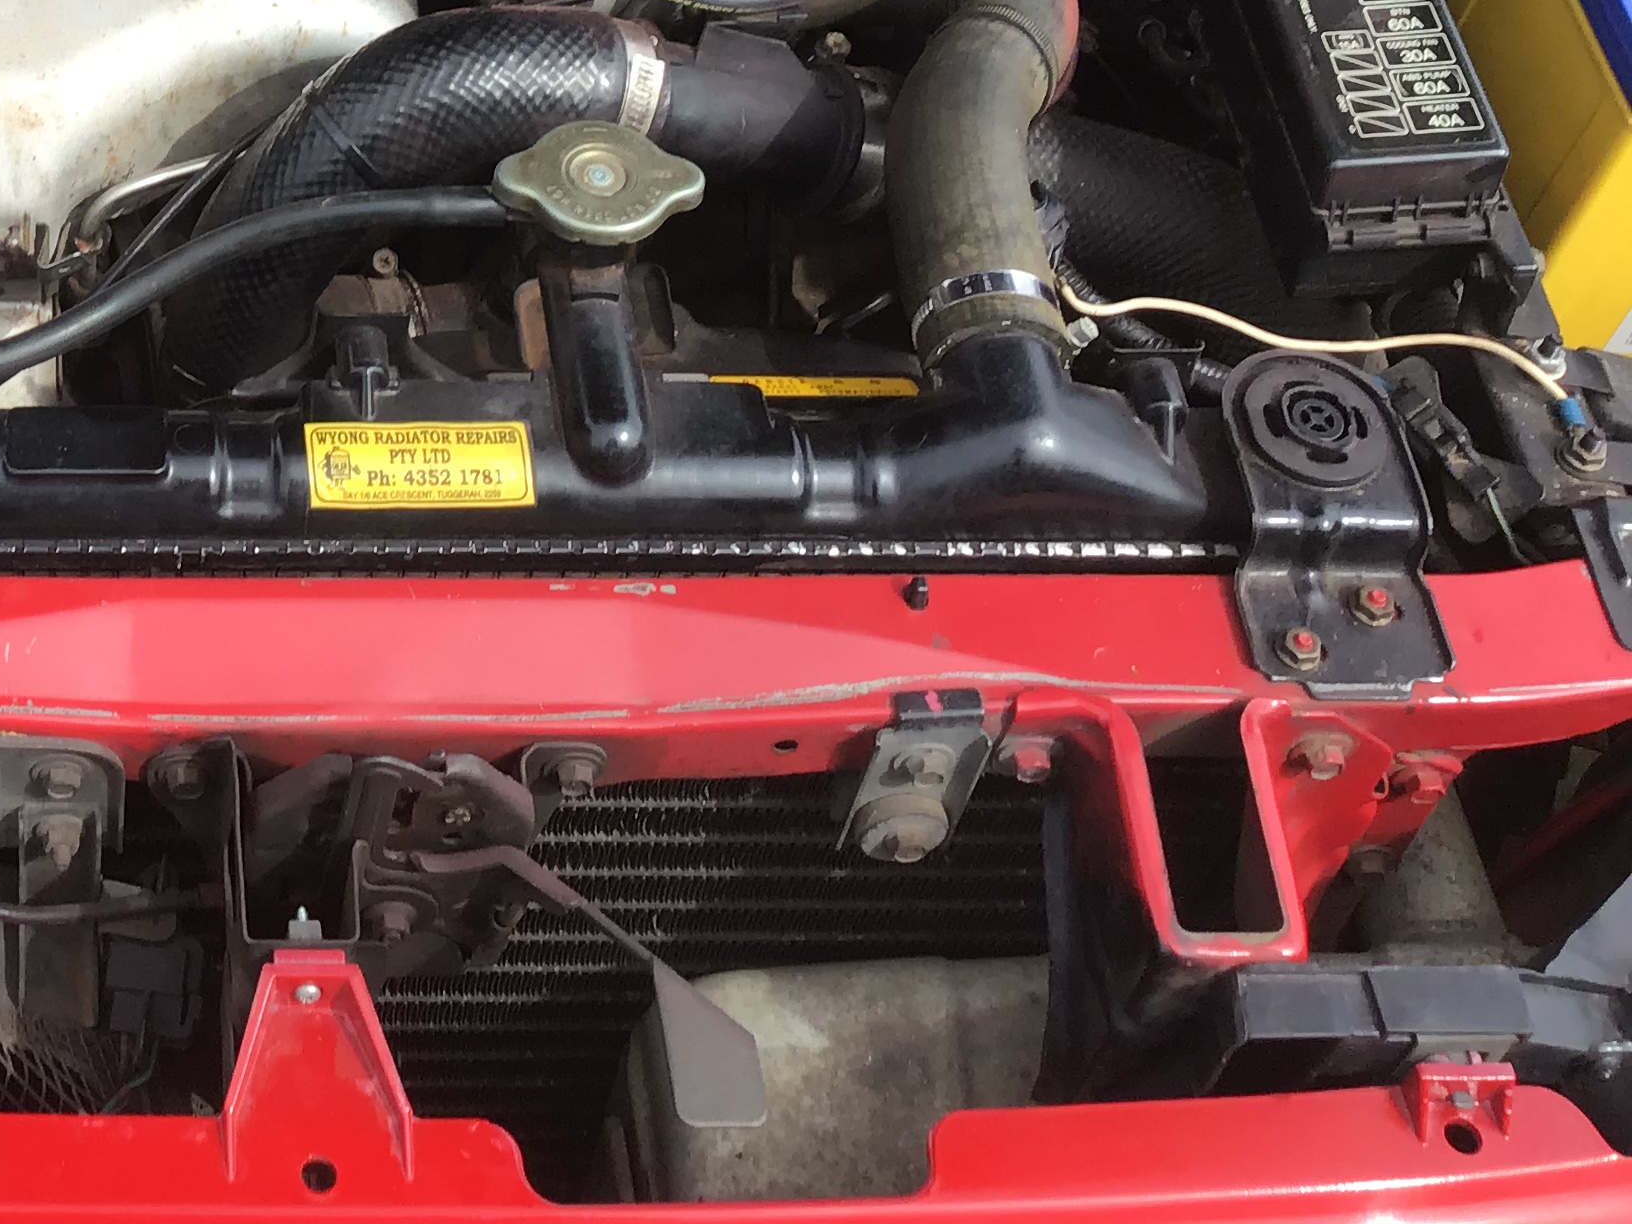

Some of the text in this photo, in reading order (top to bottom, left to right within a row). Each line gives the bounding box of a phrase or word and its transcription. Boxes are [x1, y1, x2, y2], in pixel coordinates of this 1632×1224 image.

[1387, 16, 1425, 31] 60A
[1412, 80, 1451, 95] 60A
[1427, 113, 1466, 127] 40A
[316, 430, 517, 445] WYONG RADIATOR REPAIRS
[389, 448, 451, 464] PTY LTD
[367, 468, 504, 487] Ph: 4352 1781
